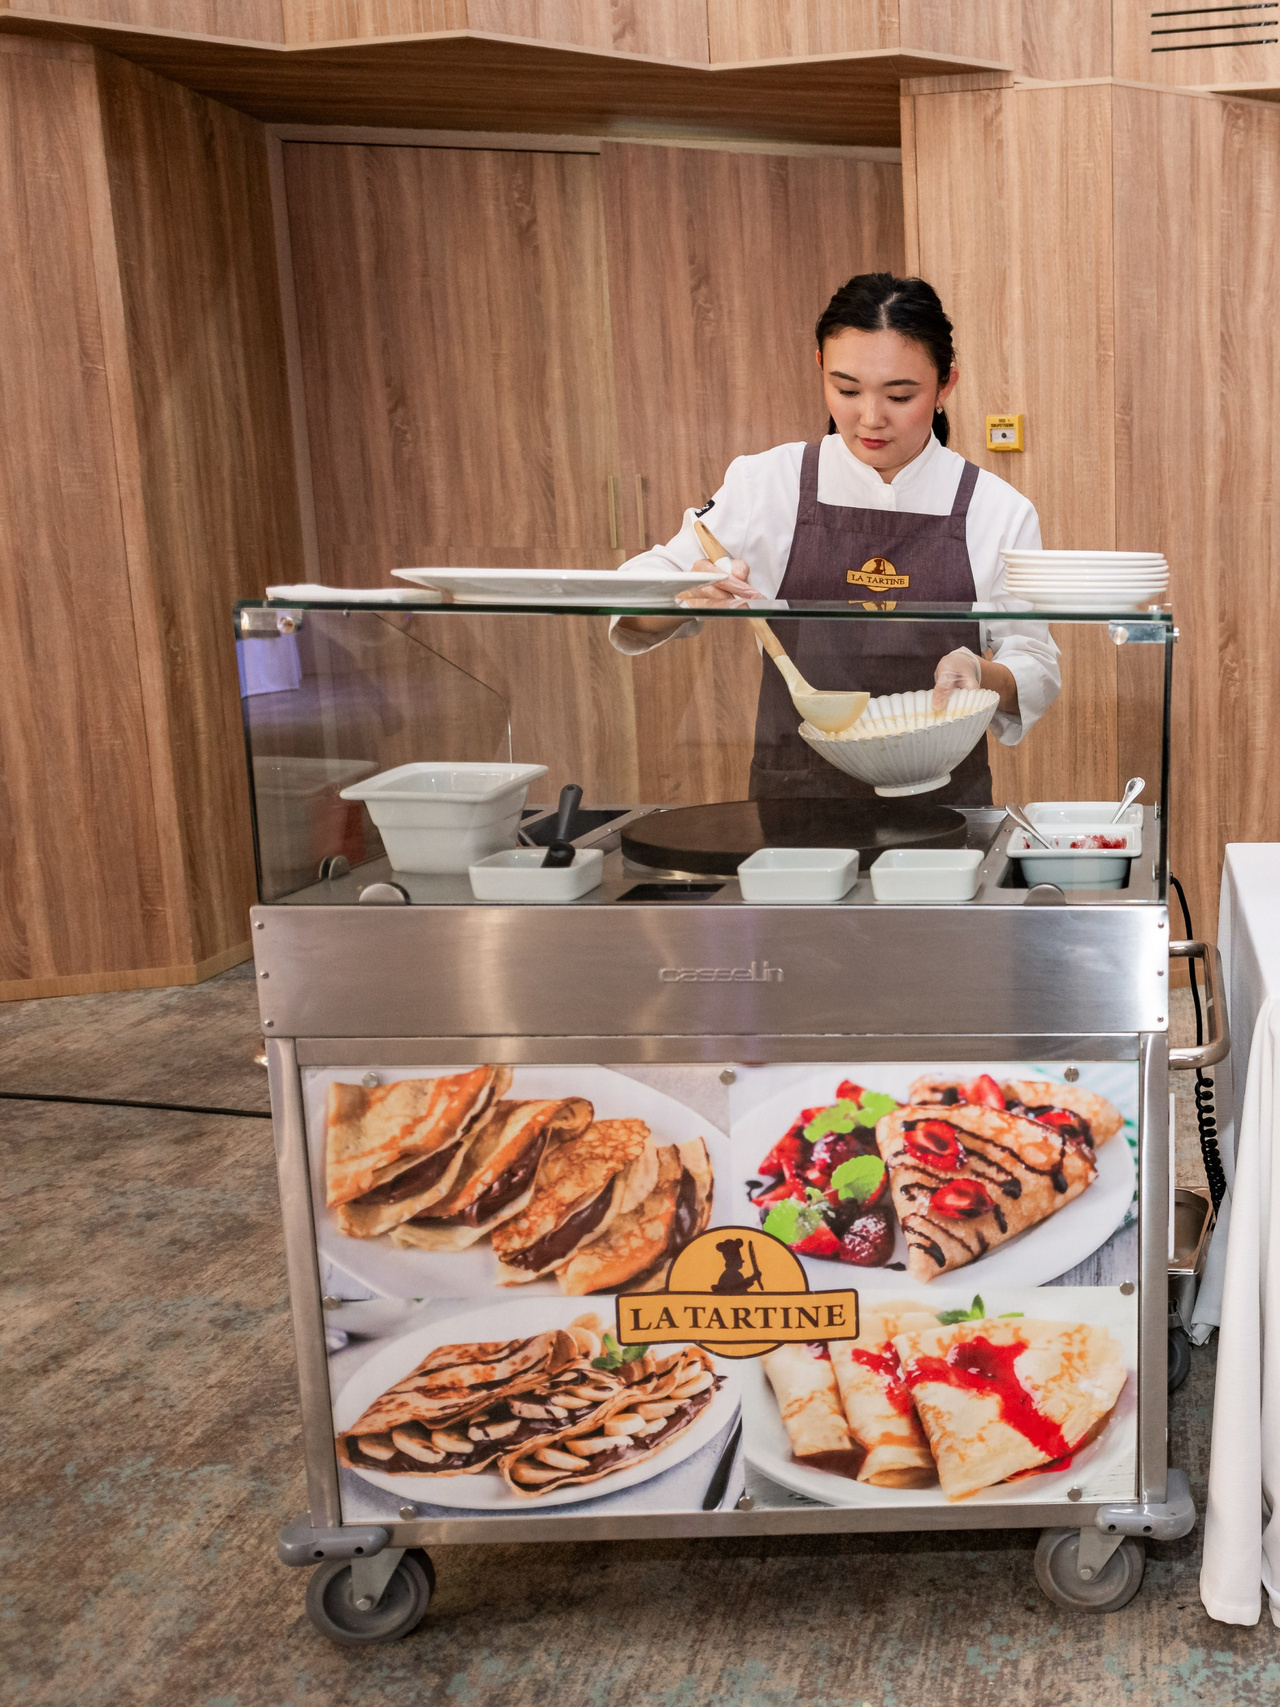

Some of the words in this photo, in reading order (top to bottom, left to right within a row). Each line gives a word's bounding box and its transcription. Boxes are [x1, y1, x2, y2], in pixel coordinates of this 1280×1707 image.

[851, 574, 864, 582] LA
[866, 576, 906, 586] TARTINE
[658, 960, 785, 983] casselin
[630, 1306, 680, 1331] LA
[683, 1304, 847, 1331] TARTINE
